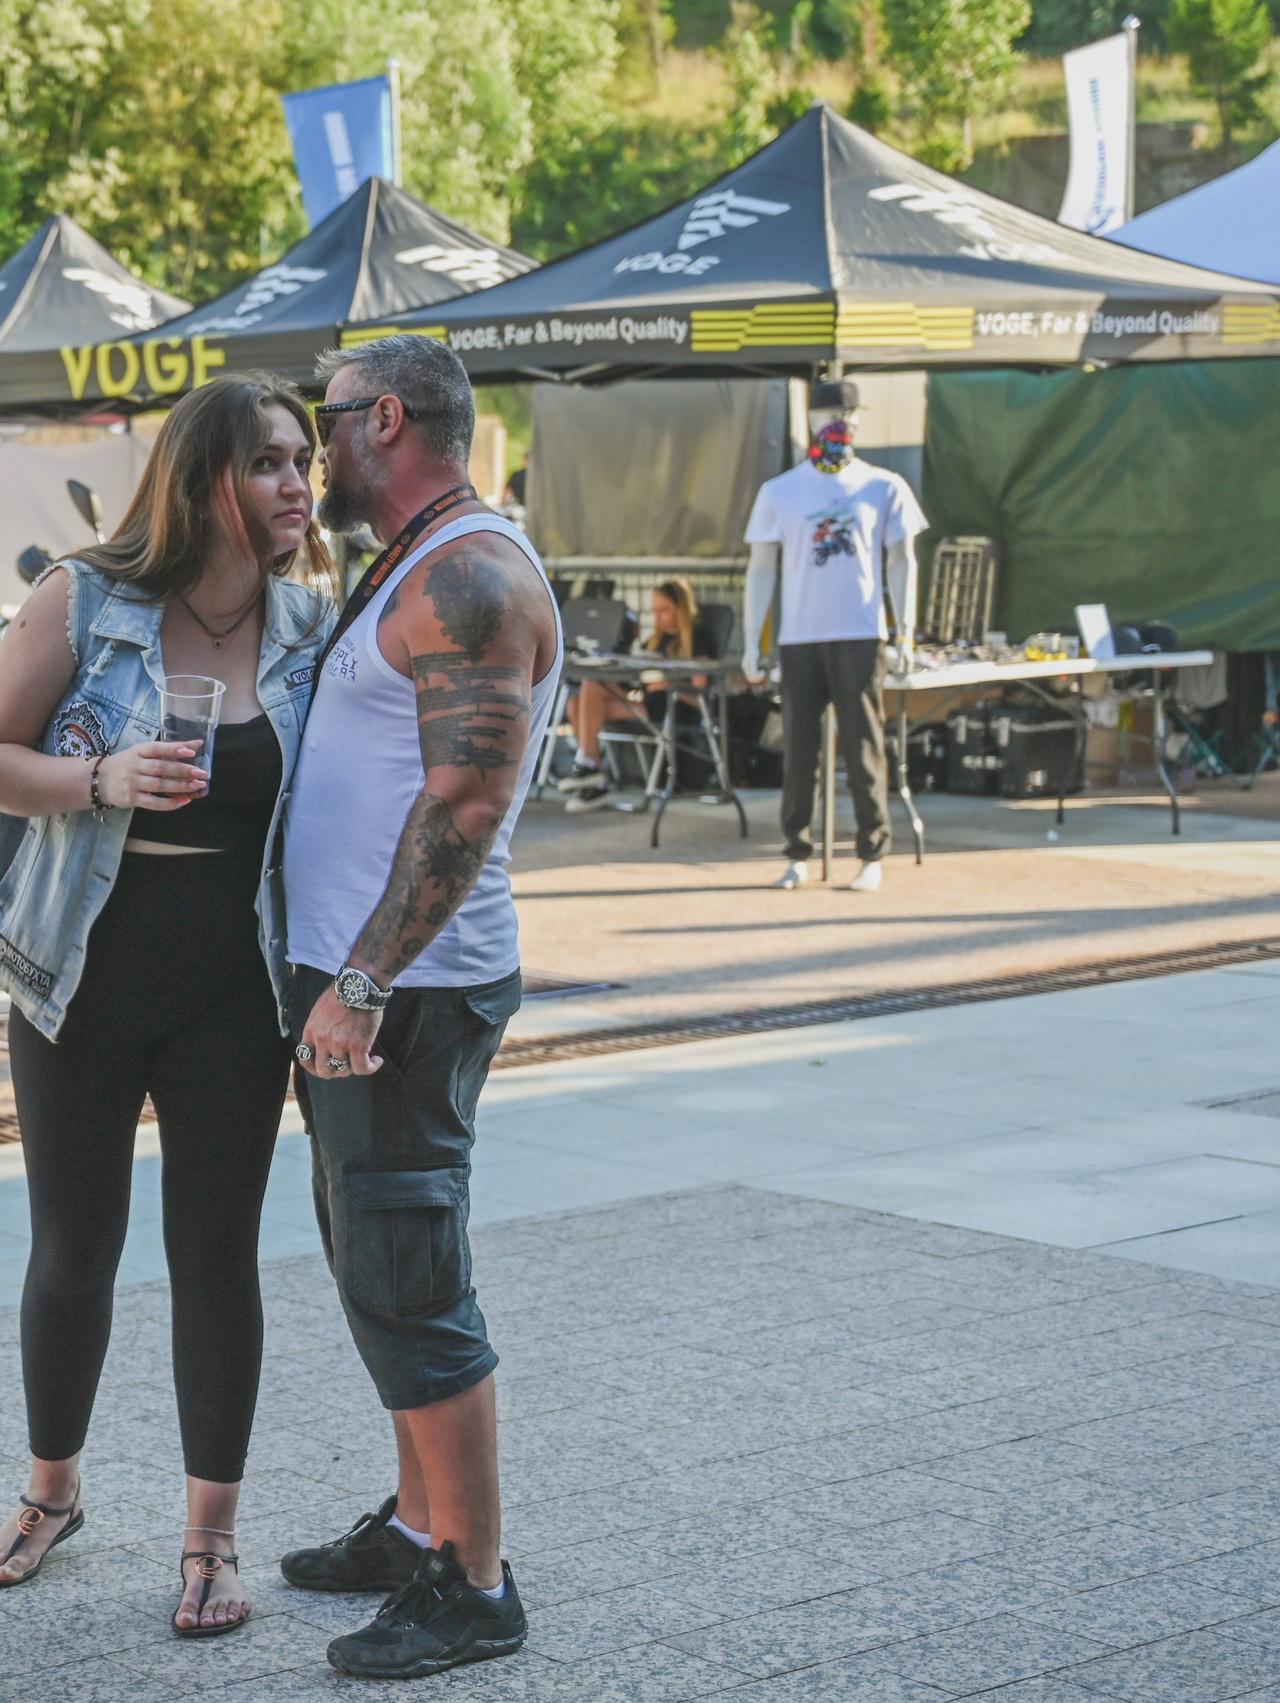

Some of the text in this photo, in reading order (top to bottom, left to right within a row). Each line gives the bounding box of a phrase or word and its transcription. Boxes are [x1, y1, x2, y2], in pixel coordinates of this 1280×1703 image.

[613, 251, 720, 277] VOGE
[449, 316, 688, 351] VOGE, Far & Beyond Quality
[976, 310, 1220, 339] VOGE, Far & Beyond Quality
[60, 333, 228, 400] VOGE
[6, 945, 51, 988] МОТОБУХТА
